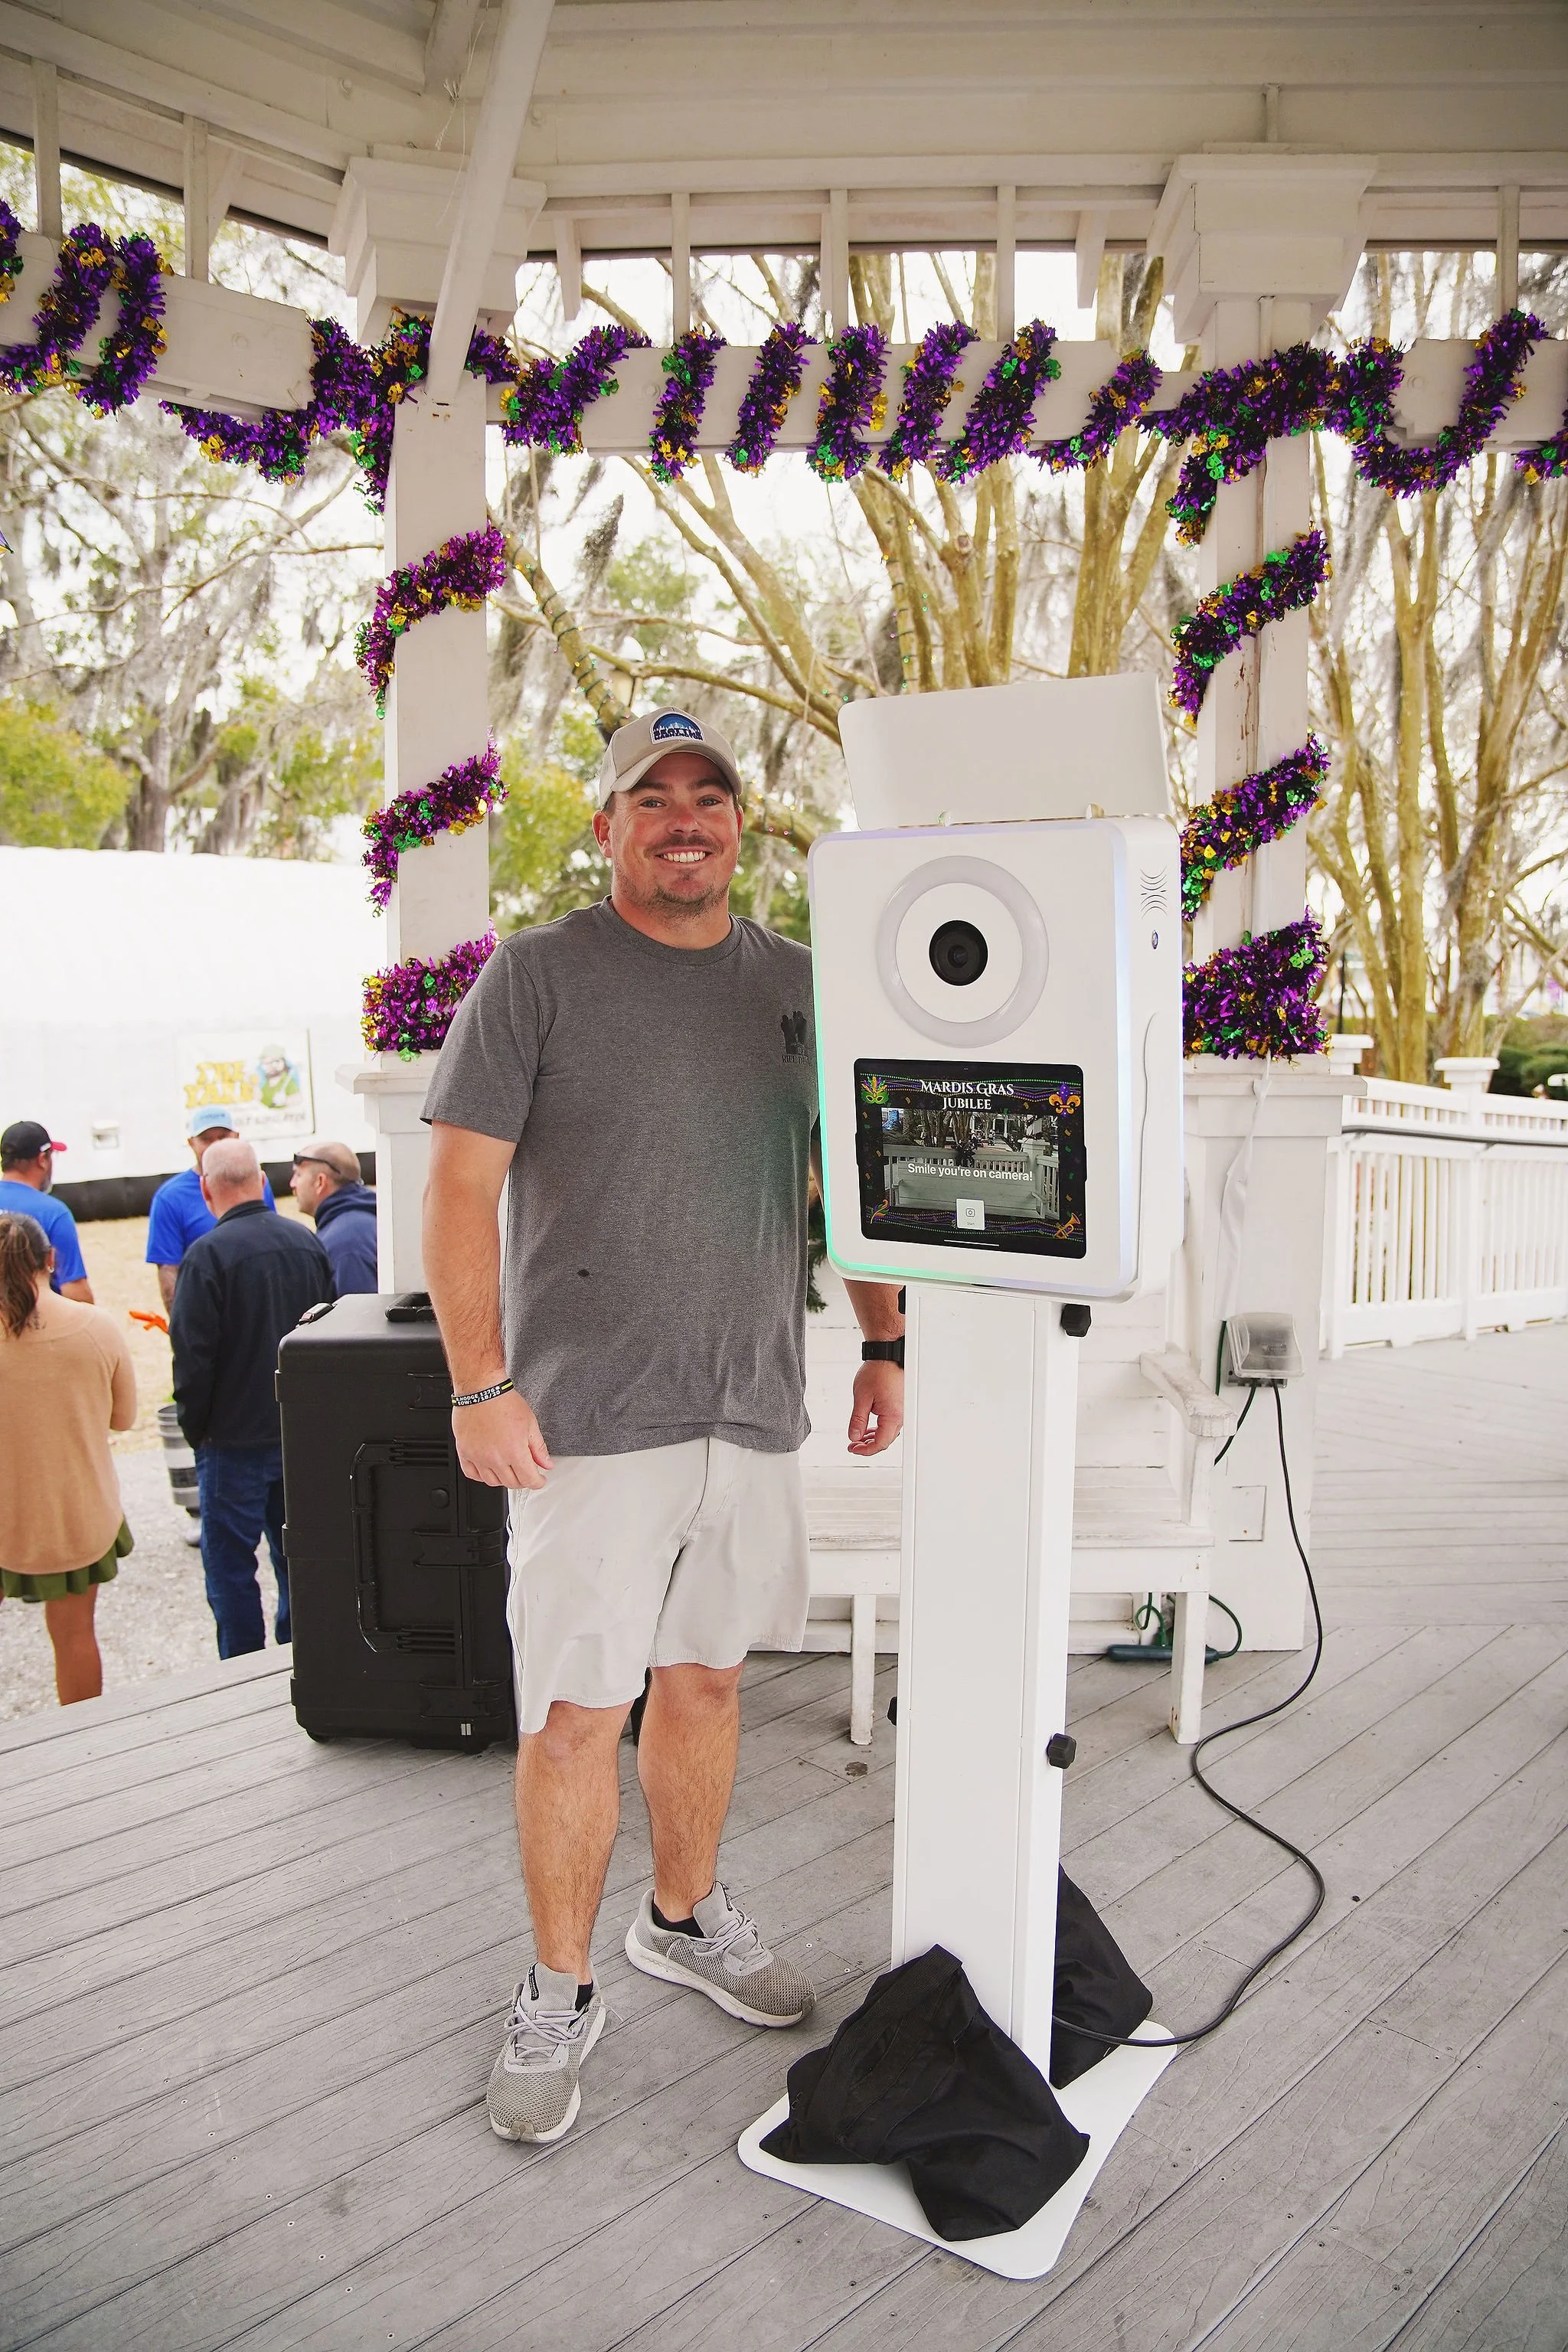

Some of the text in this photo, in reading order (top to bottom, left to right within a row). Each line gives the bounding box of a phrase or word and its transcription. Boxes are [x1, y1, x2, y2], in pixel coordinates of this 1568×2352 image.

[919, 1079, 1014, 1096] MARDIS GRAS
[942, 1097, 991, 1110] JUBILEE
[907, 1163, 1033, 1181] Smile you're on camera!
